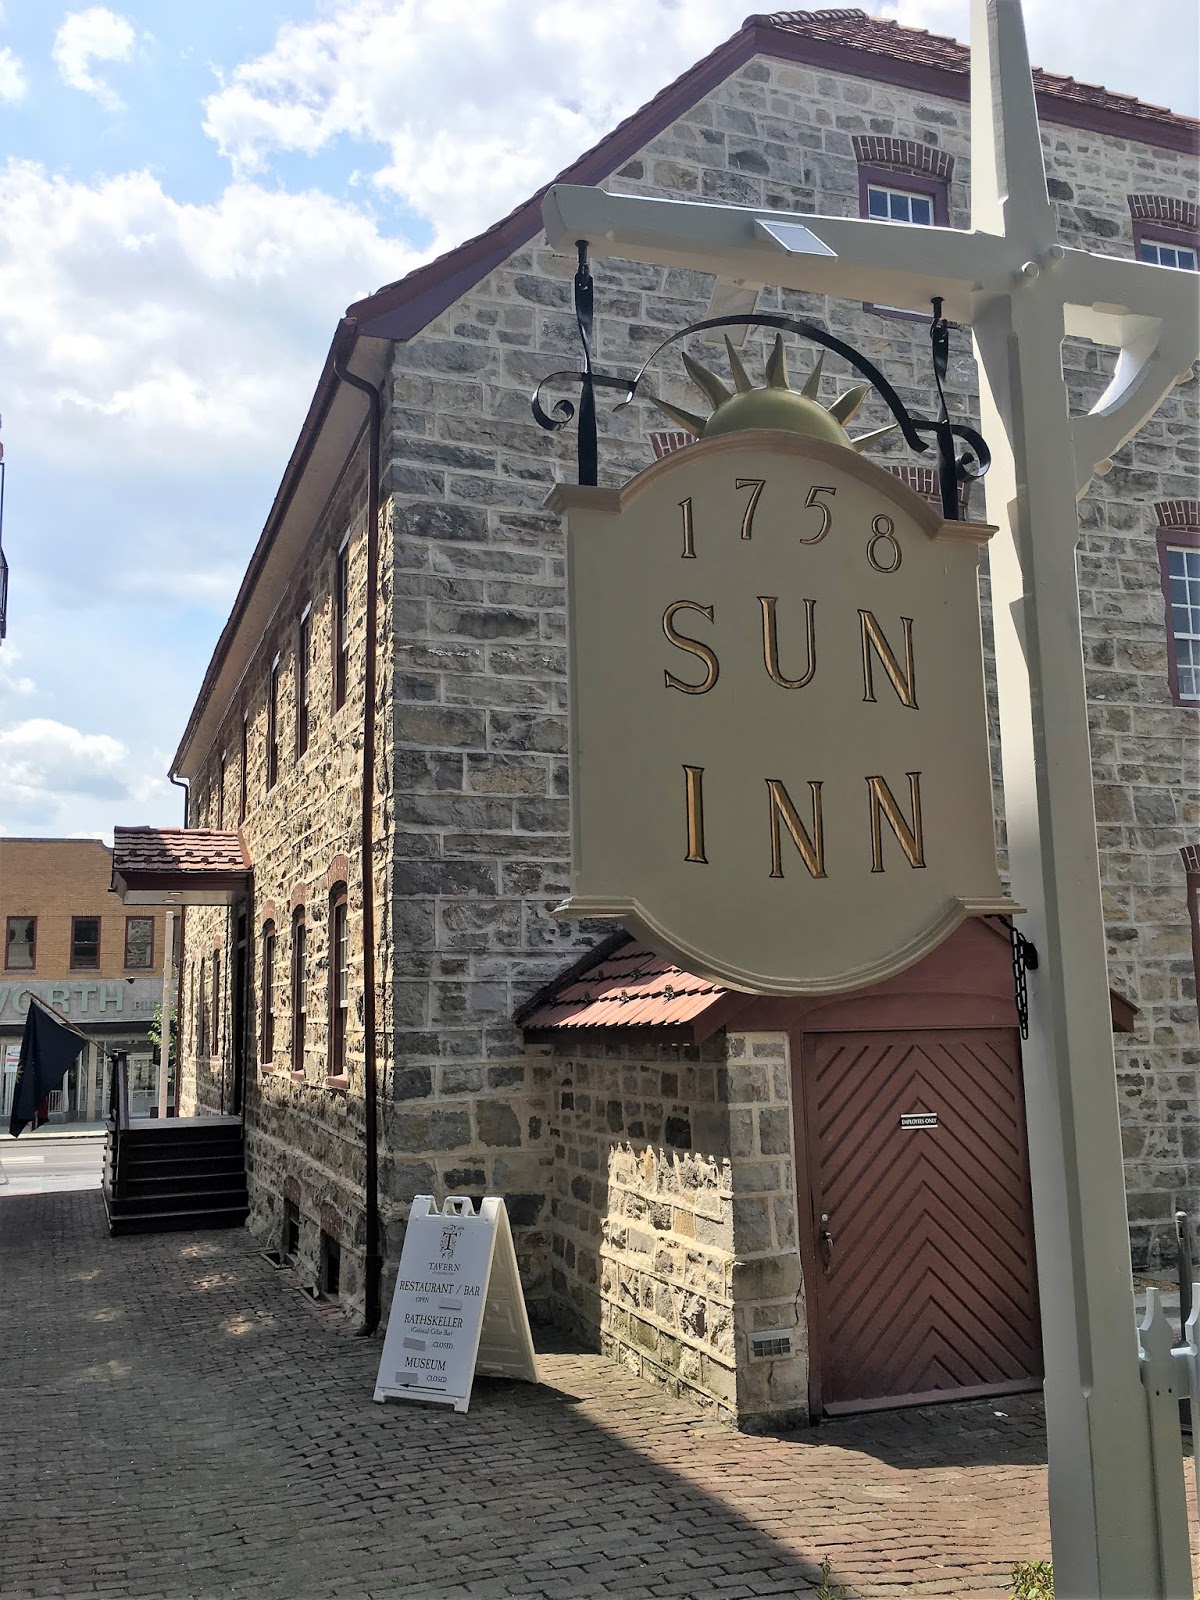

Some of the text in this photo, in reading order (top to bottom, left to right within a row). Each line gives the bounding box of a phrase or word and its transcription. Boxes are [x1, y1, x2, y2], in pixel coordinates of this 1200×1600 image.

[678, 478, 902, 574] 1758
[662, 596, 920, 711] SUN
[682, 764, 927, 880] INN
[0, 985, 124, 1015] ORTH
[429, 1262, 461, 1272] TAVERN
[400, 1280, 454, 1294] RESTAURANT
[464, 1285, 480, 1296] BAR
[416, 1296, 430, 1304] OPEN
[404, 1313, 463, 1328] RATHSKELLER
[432, 1341, 453, 1349] CLOSED
[405, 1356, 447, 1371] MUSEUM
[426, 1374, 447, 1383] CLOSED
